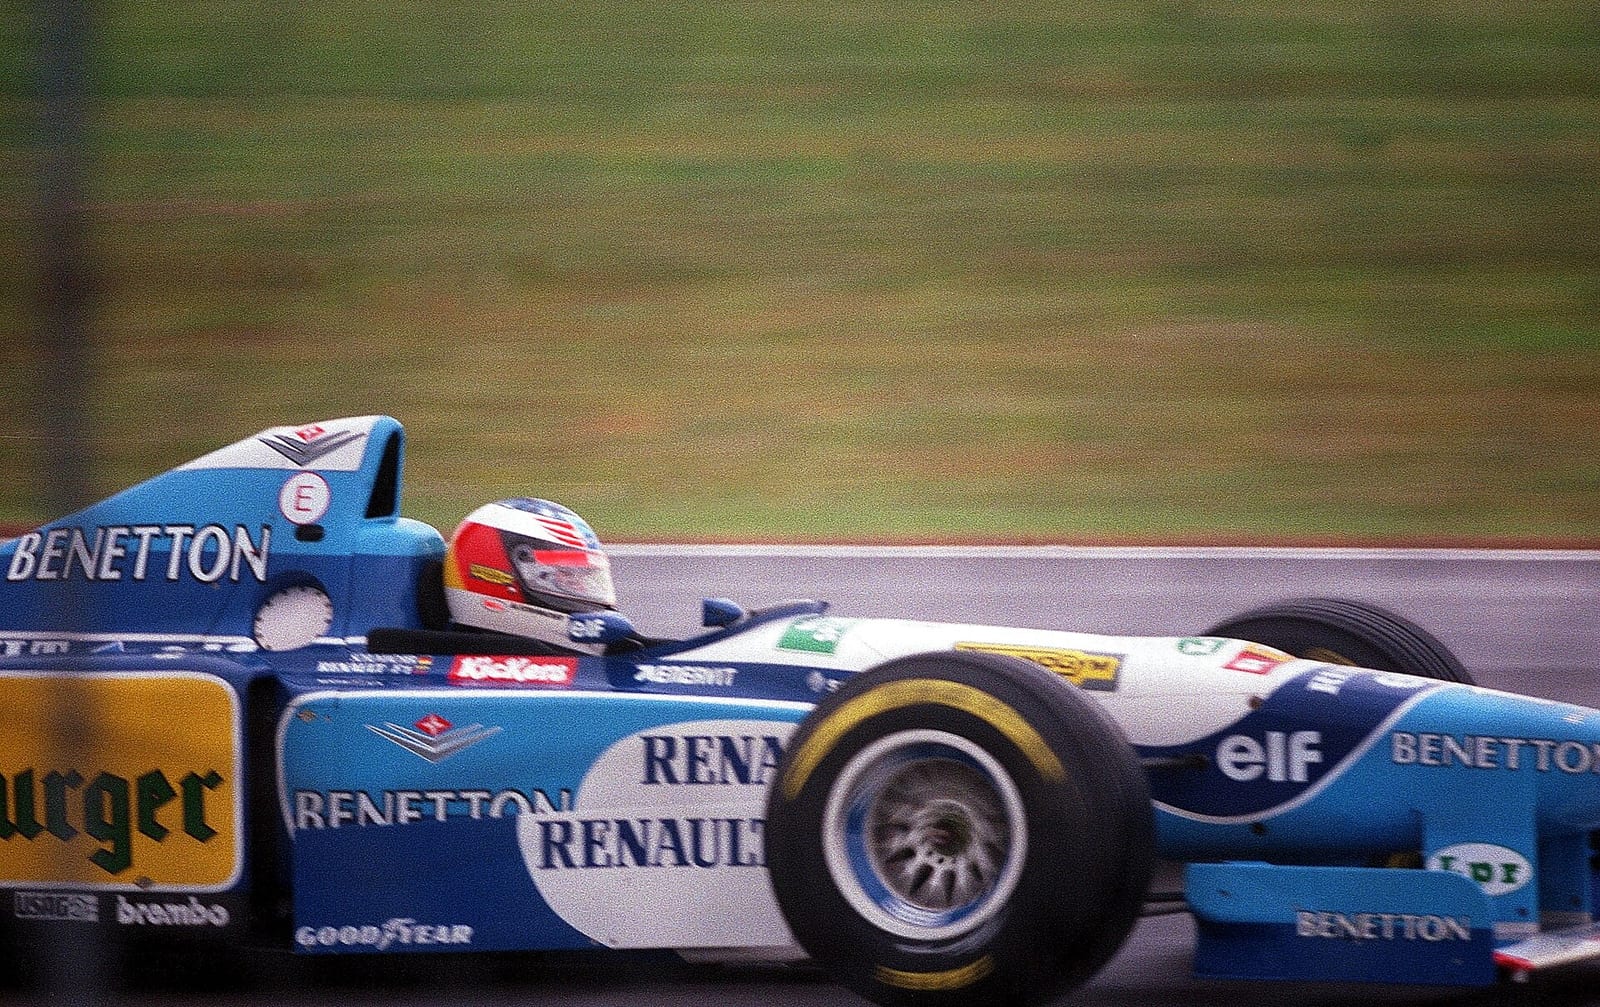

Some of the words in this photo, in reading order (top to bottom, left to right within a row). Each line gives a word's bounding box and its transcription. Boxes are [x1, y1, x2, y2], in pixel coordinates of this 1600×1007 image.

[294, 483, 315, 512] E
[6, 523, 273, 582] BENETTON
[569, 618, 607, 638] elf
[1216, 730, 1324, 782] elf
[115, 895, 230, 927] brembo
[1295, 910, 1473, 942] BENETTON
[294, 917, 475, 951] GOODYEAR
